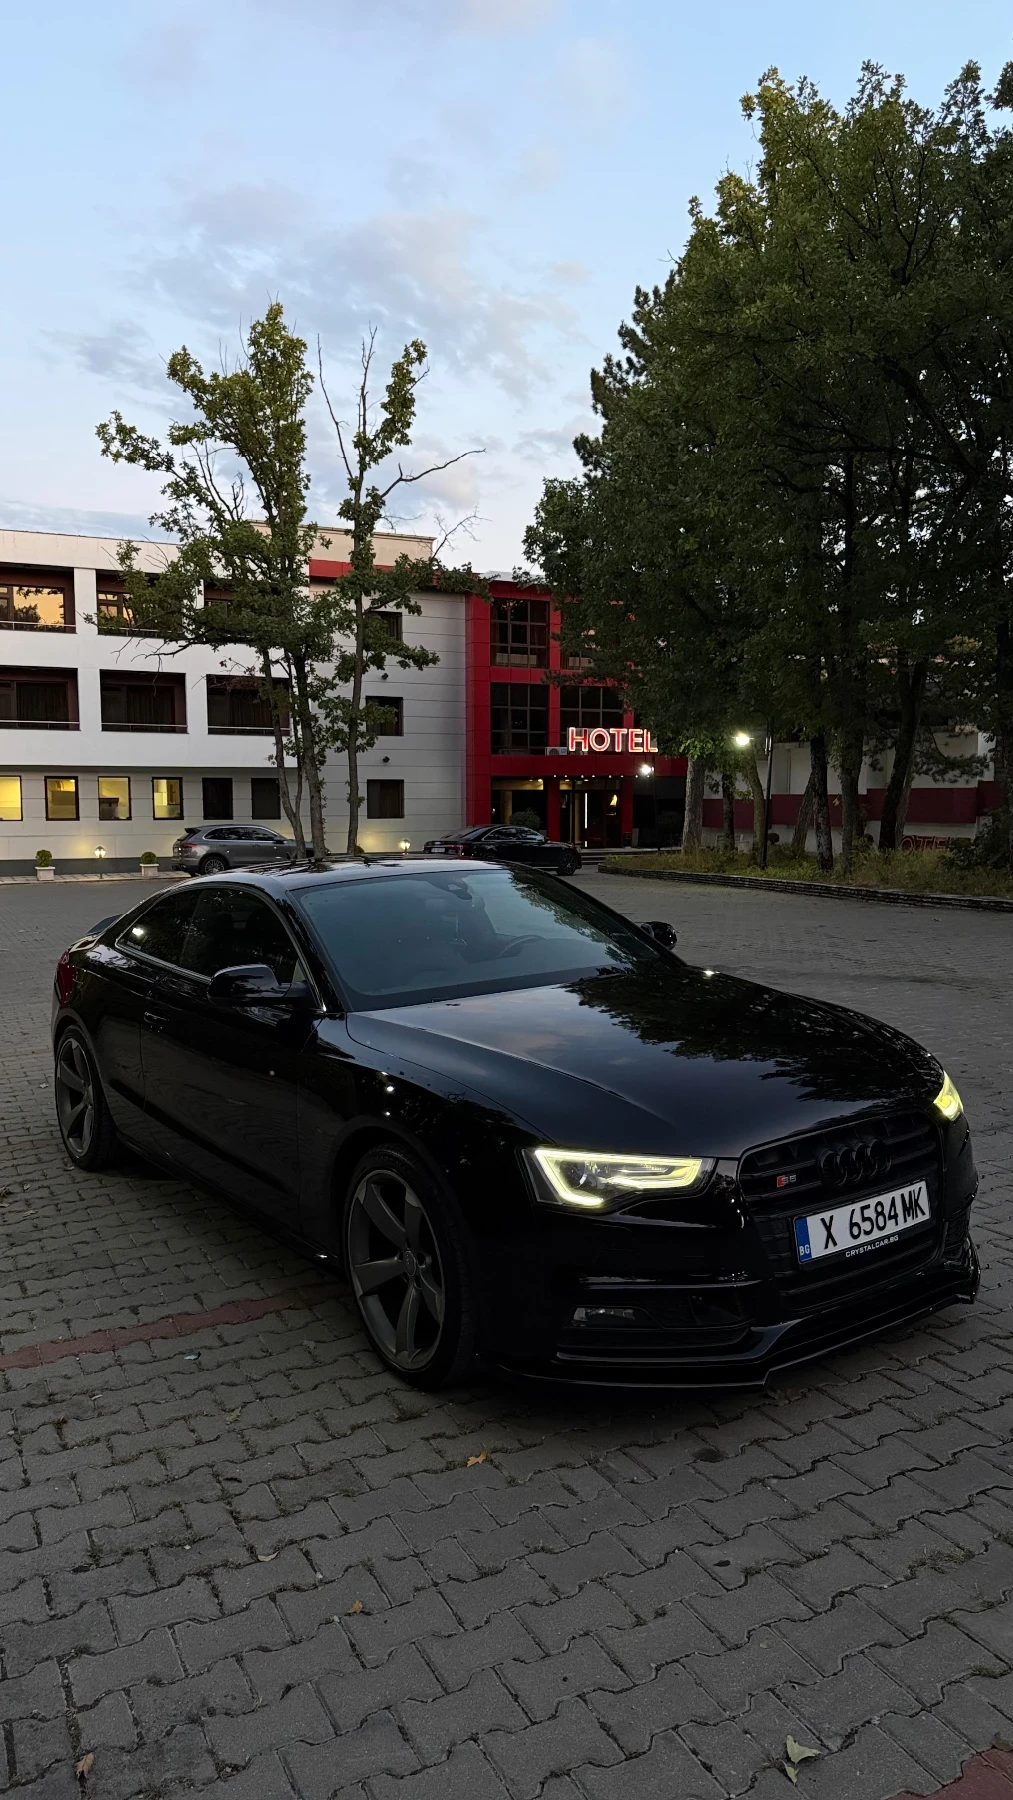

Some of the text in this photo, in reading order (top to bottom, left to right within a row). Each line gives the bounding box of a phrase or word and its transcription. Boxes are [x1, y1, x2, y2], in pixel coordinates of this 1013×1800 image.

[568, 727, 659, 753] HOTEL
[820, 1187, 926, 1250] X 6584 MK
[799, 1244, 811, 1256] BG
[845, 1235, 899, 1258] CRYSTALCAR.BG
